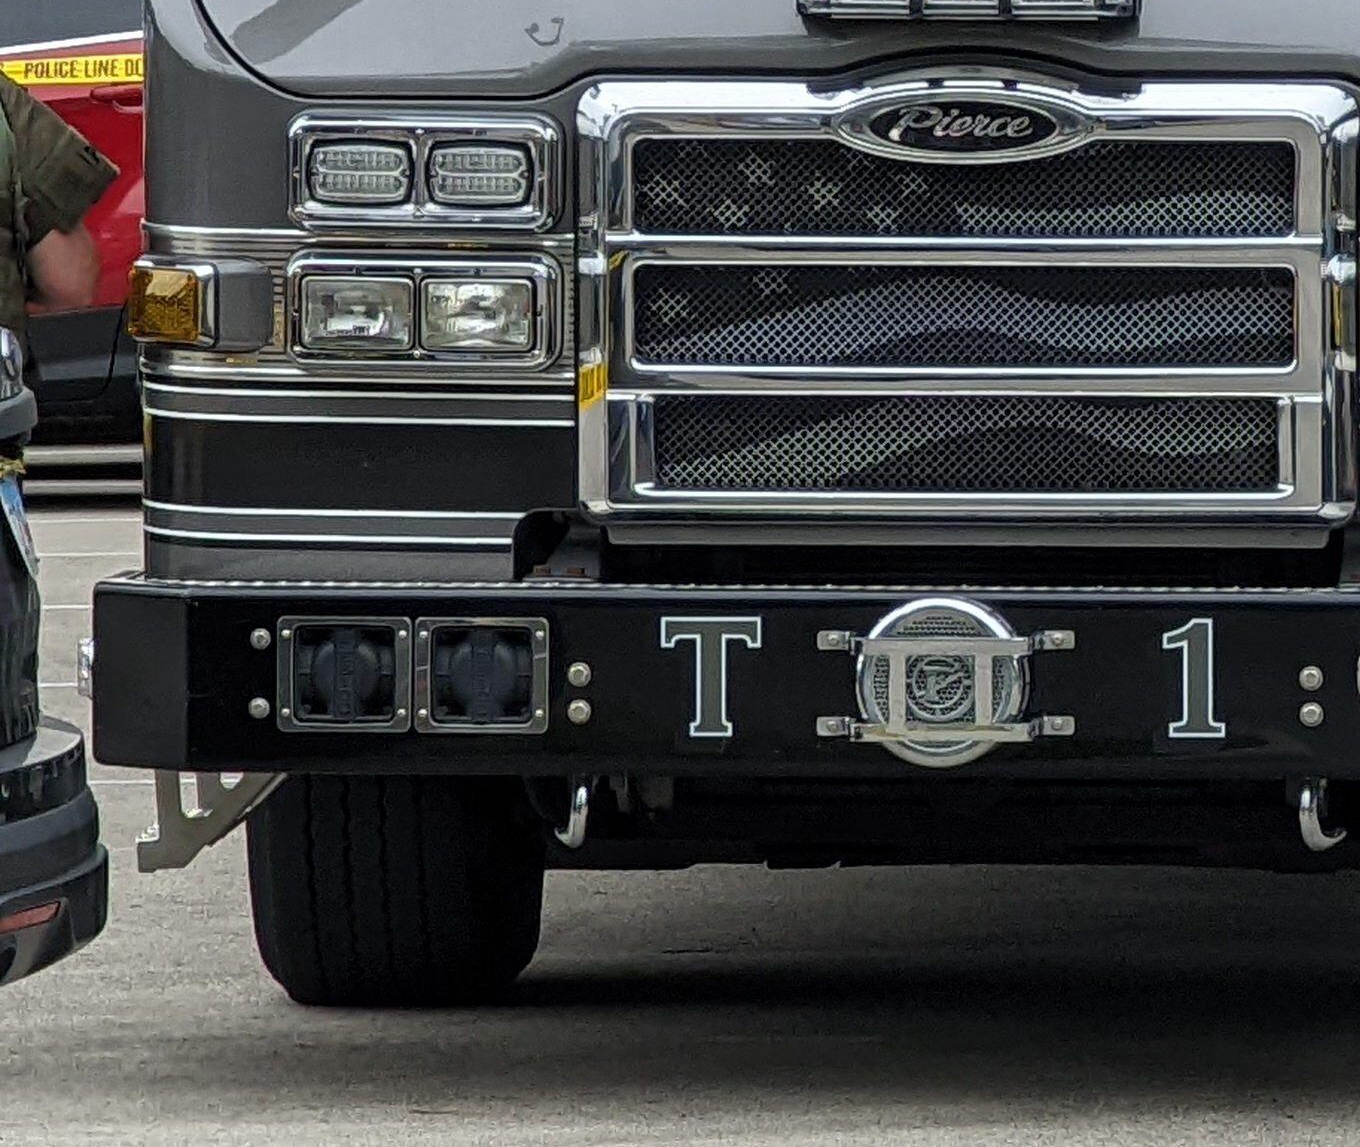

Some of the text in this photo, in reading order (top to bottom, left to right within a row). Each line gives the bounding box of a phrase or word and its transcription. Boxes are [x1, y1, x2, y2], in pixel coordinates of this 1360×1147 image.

[24, 59, 79, 79] POLICE
[84, 58, 119, 78] LINE
[888, 105, 1033, 141] Pierce
[660, 616, 1226, 738] T 1
